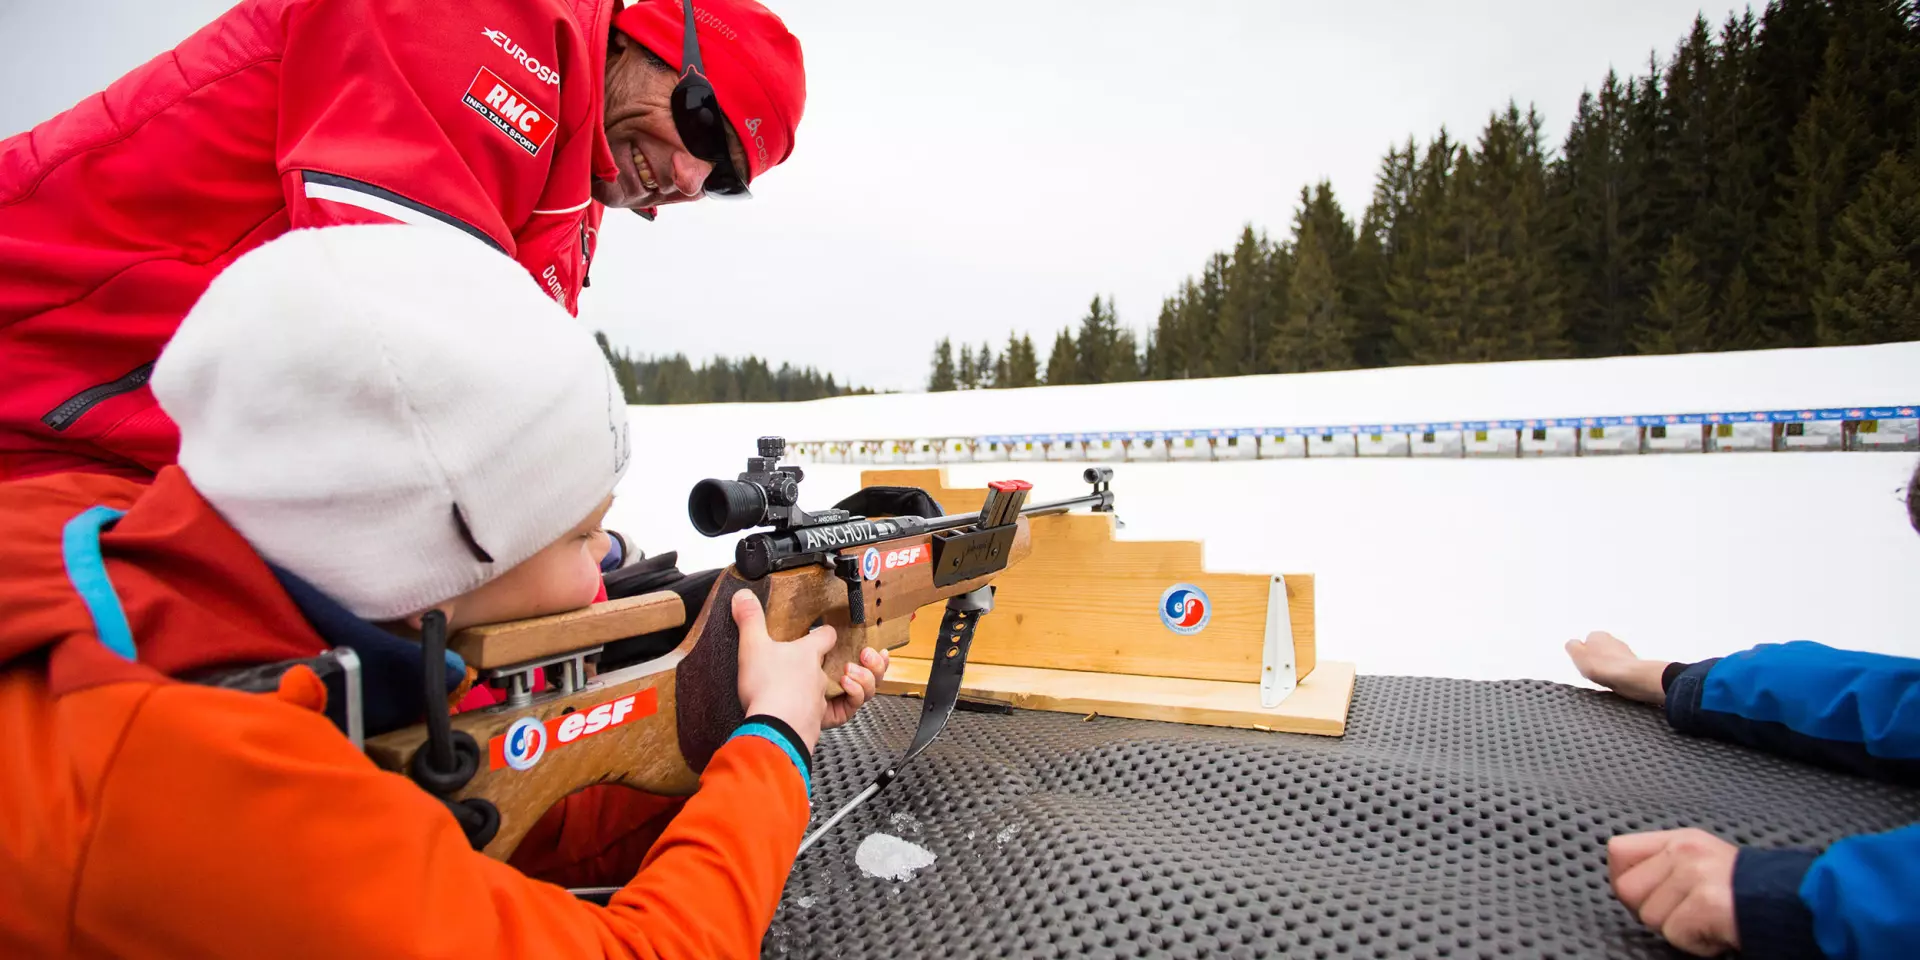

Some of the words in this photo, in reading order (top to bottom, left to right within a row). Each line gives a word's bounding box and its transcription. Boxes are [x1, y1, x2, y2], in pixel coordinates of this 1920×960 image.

[465, 95, 488, 114] INFO
[488, 111, 510, 132] TALK
[509, 130, 538, 152] SPORT
[485, 83, 541, 133] RMC
